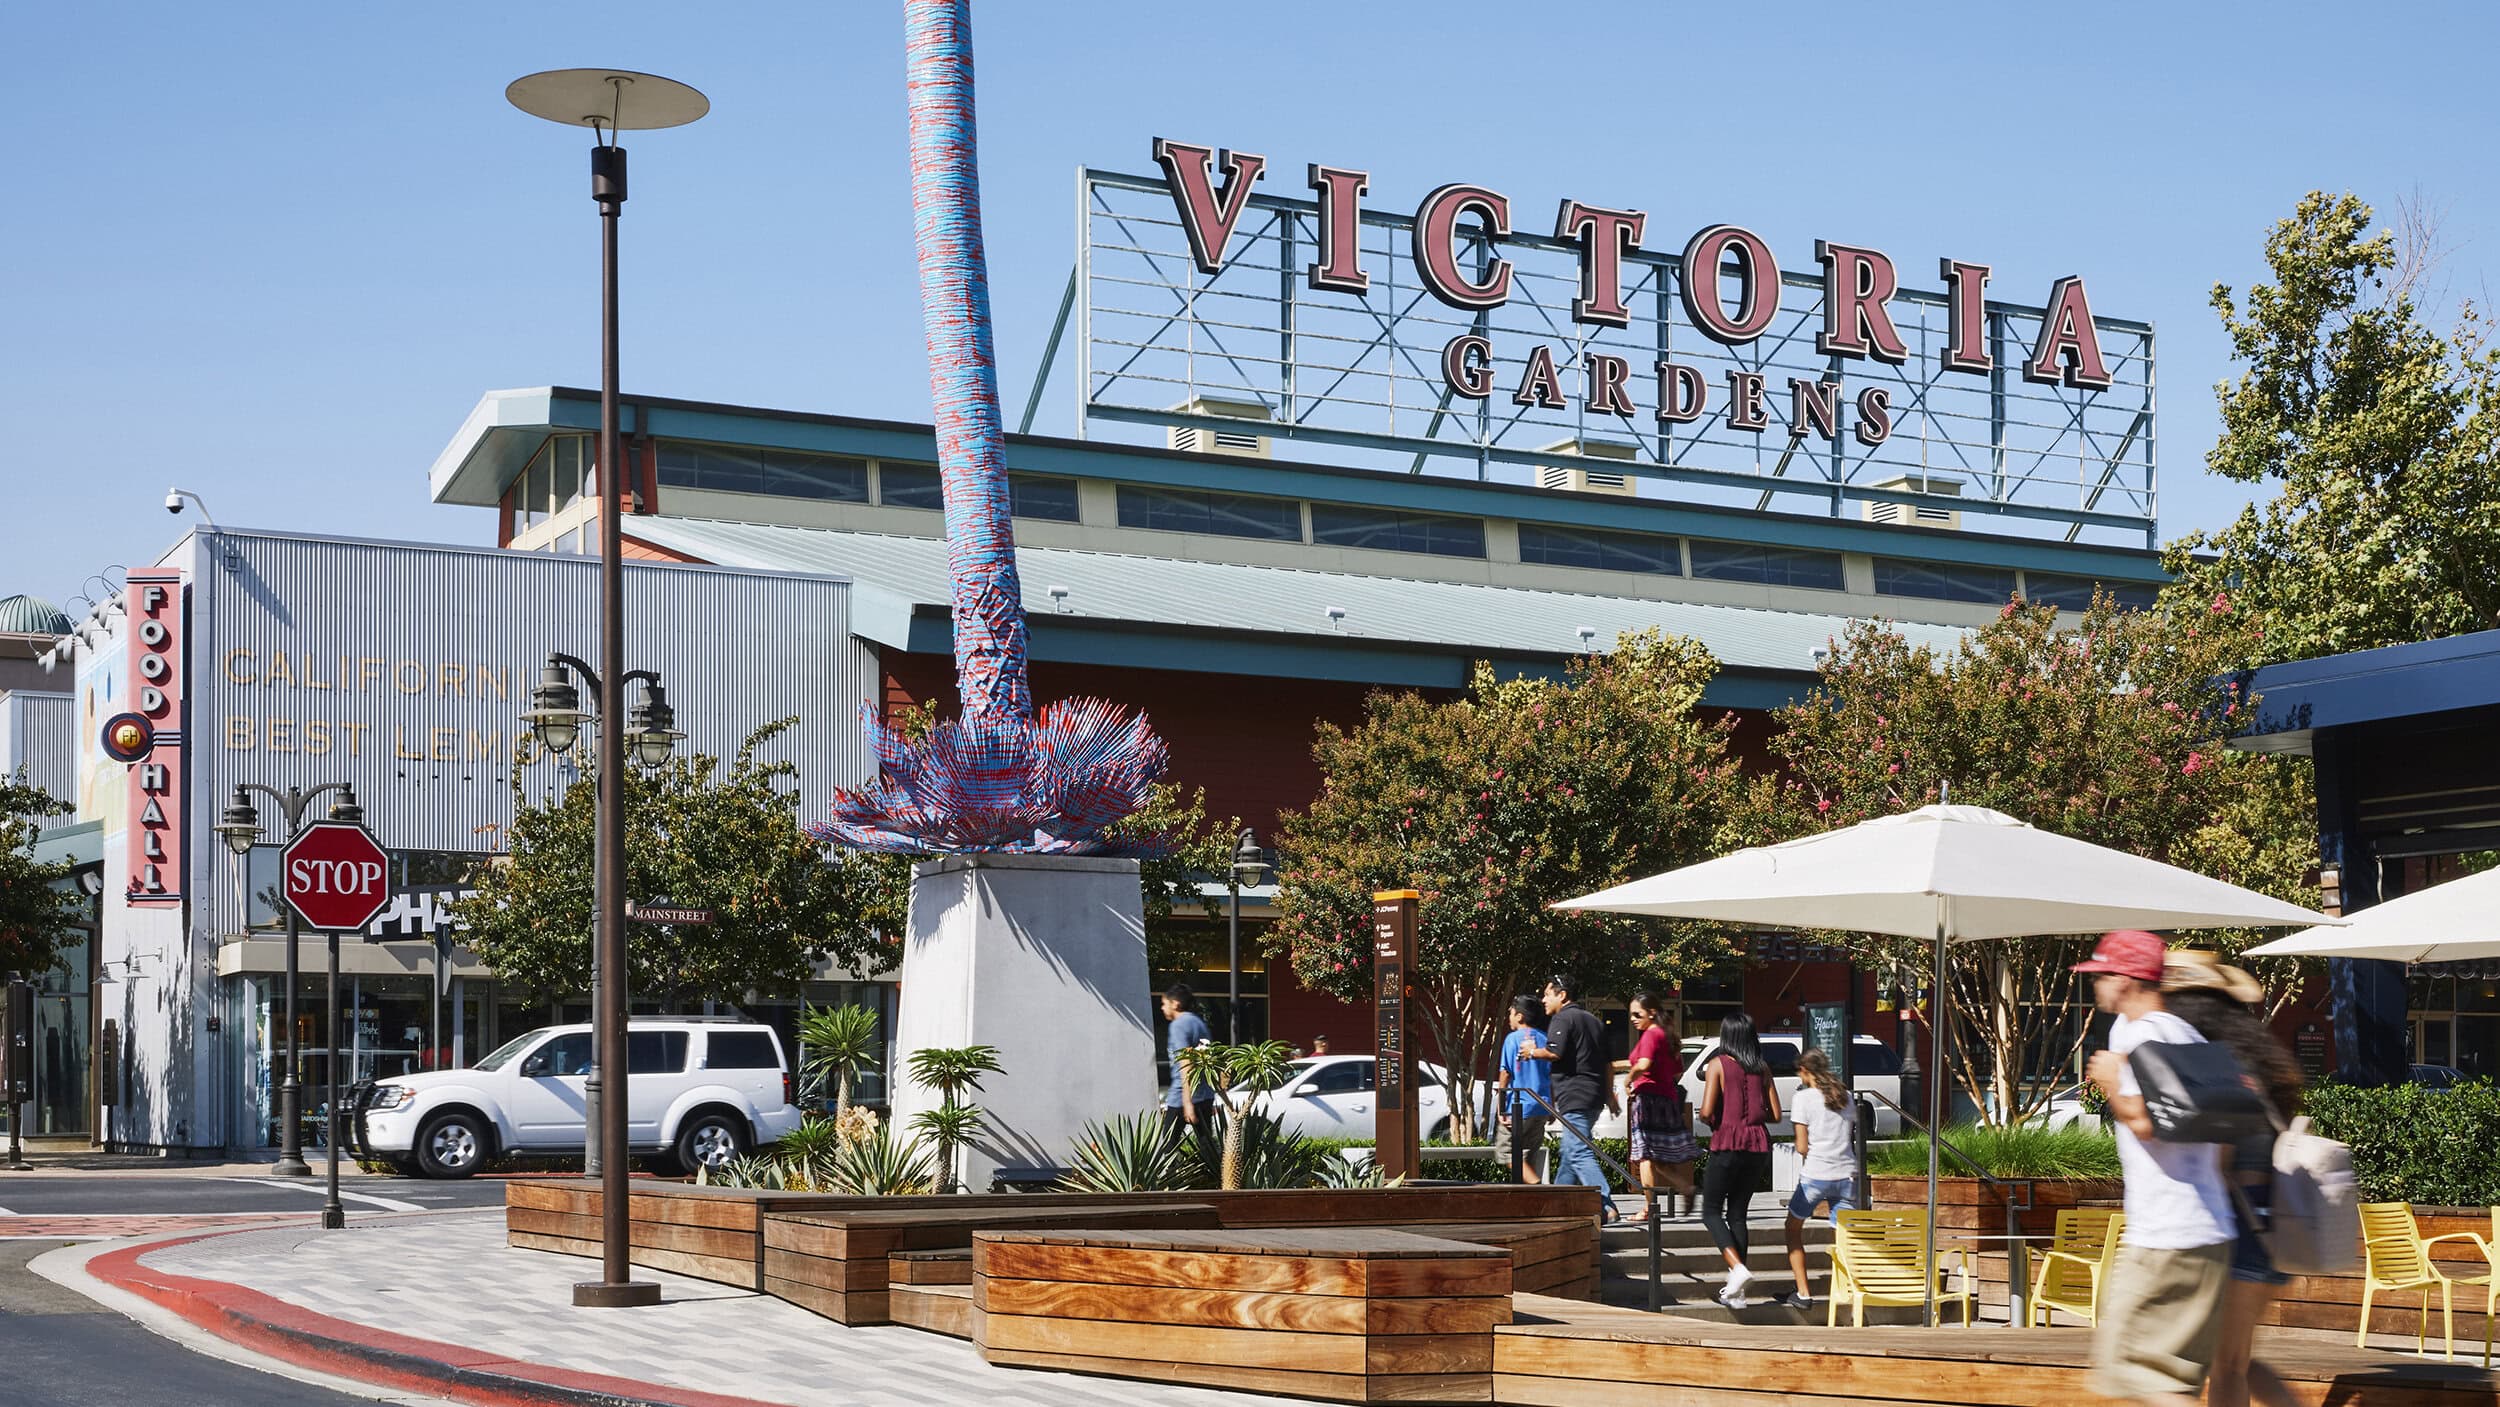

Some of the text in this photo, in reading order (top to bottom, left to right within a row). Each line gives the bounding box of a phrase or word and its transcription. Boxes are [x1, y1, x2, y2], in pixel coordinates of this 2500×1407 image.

[1153, 136, 2113, 392] VICTORIA
[1442, 335, 1892, 446] GARDENS
[139, 585, 165, 713] FOOD
[223, 647, 592, 706] CALIFORNI
[123, 729, 138, 744] FH
[224, 714, 369, 758] BEST
[140, 763, 164, 891] HALL
[291, 858, 382, 895] STOP
[1814, 1016, 1838, 1033] Hours
